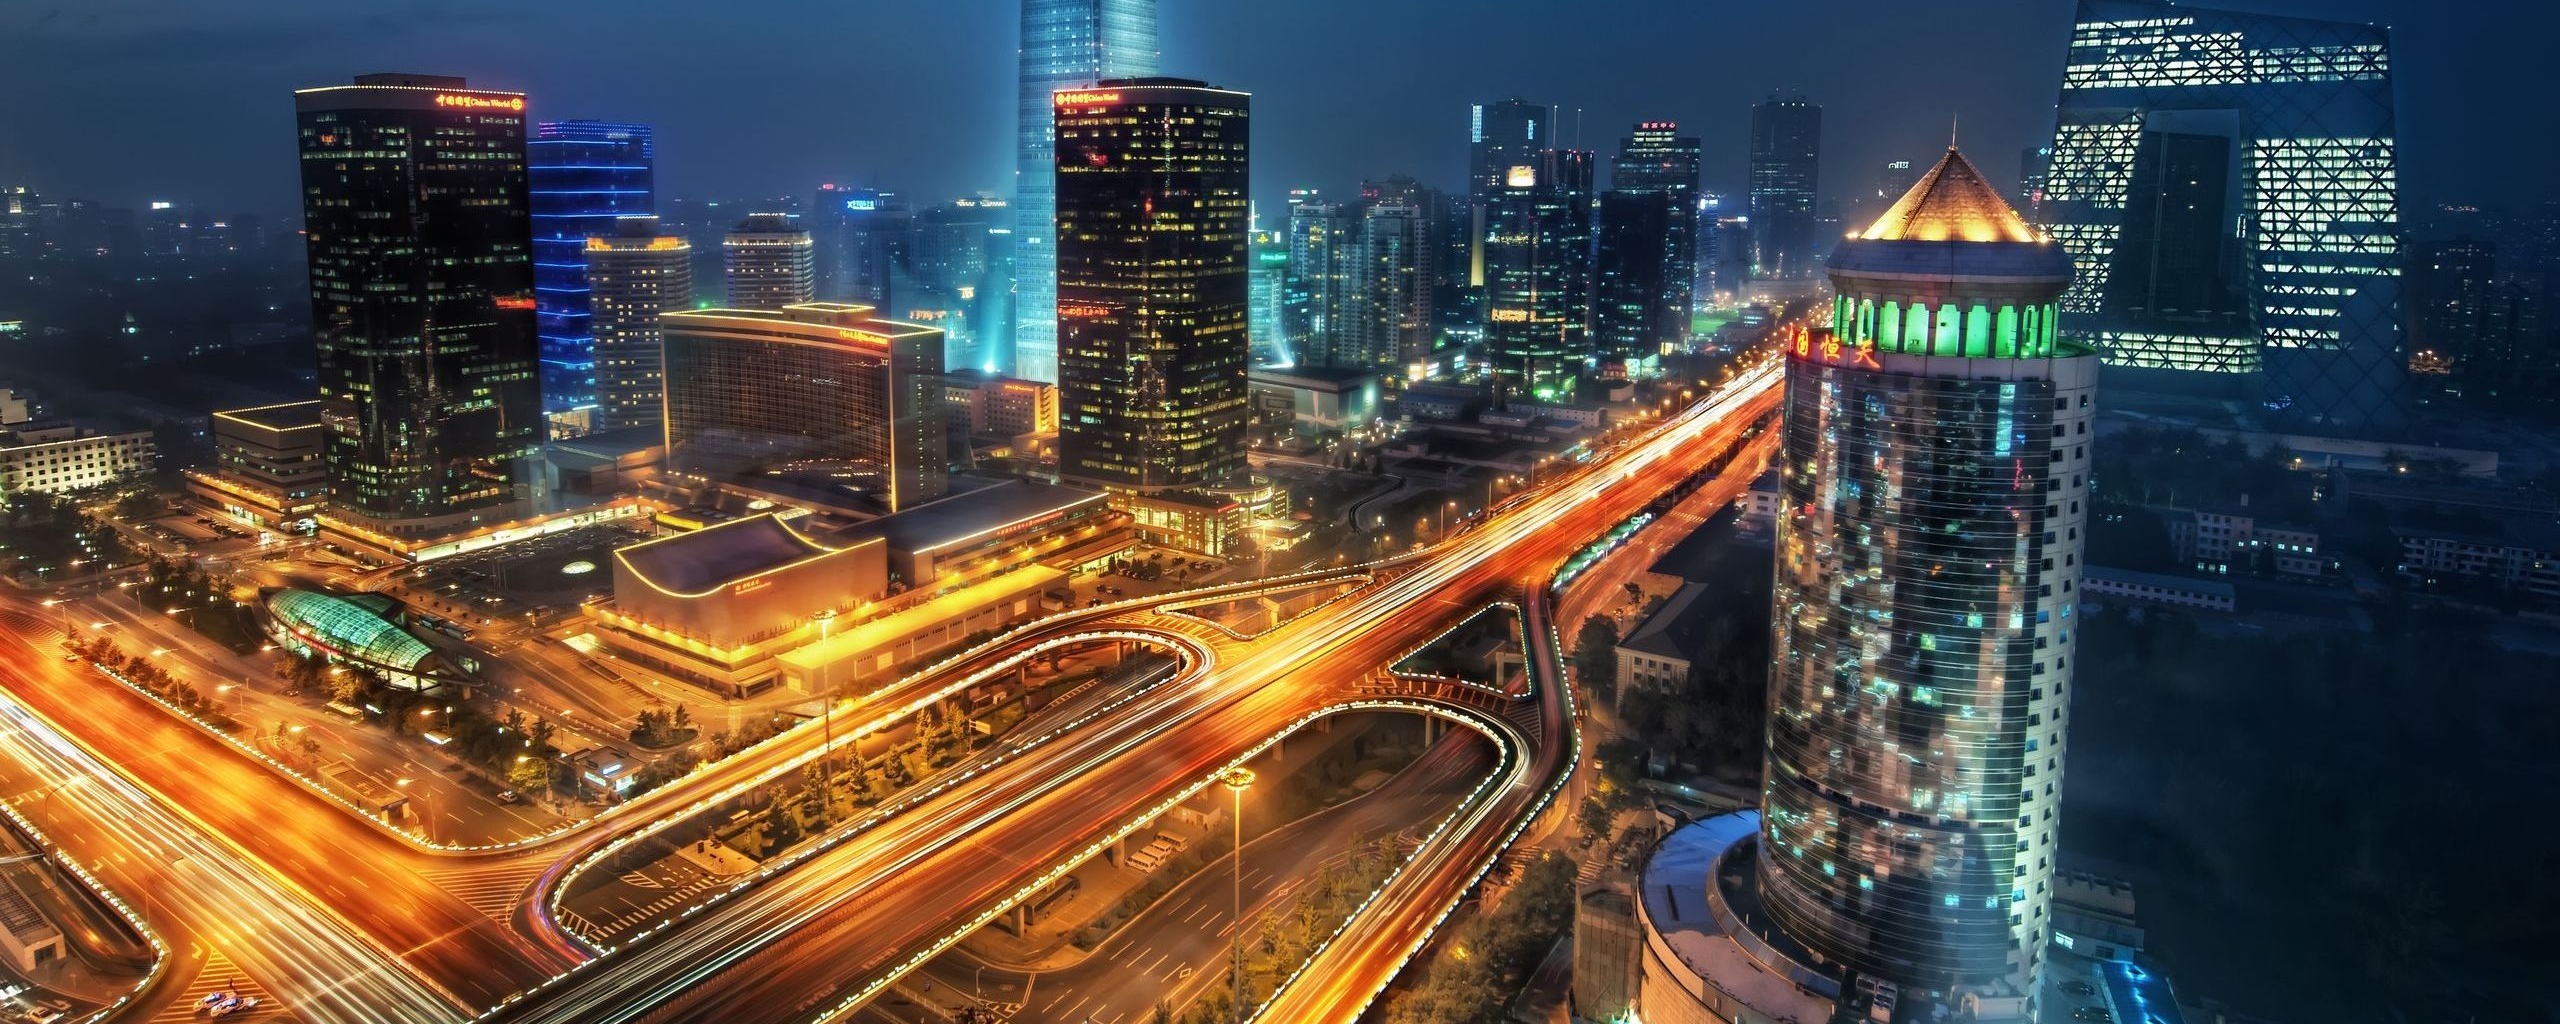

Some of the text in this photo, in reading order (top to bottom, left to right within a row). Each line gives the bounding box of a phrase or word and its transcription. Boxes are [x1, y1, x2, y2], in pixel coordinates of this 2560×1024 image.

[471, 98, 490, 107] China
[490, 99, 510, 108] World
[1788, 322, 1881, 369] 国恒天
